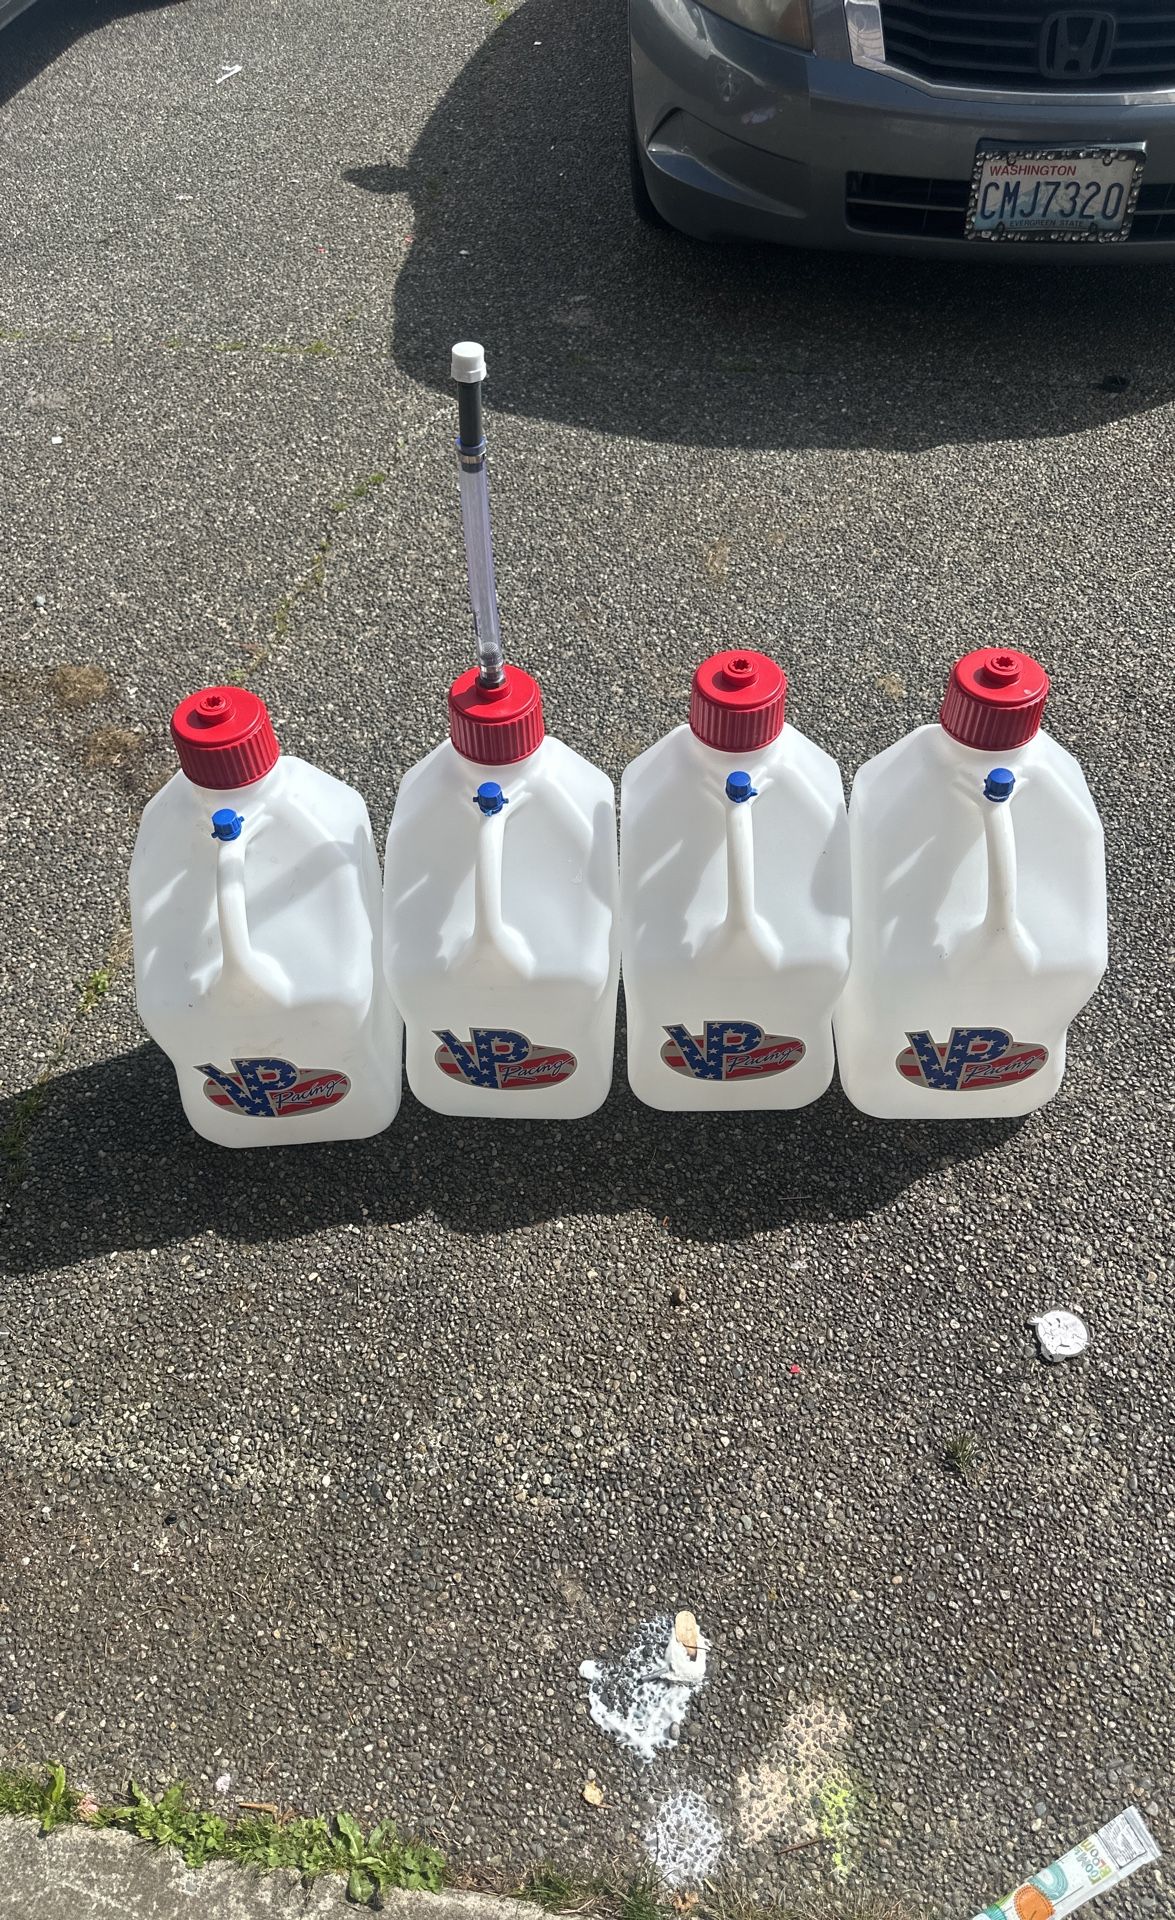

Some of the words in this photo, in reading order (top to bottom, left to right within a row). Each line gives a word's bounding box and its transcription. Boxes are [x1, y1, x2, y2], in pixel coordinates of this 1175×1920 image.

[990, 165, 1077, 176] WASHINGTON
[980, 180, 1124, 221] CMJ7320
[1009, 219, 1055, 227] EVERGREEN
[1058, 219, 1084, 227] STATE
[432, 1027, 531, 1088] VP
[663, 1021, 765, 1080] VP
[728, 1044, 804, 1072] Racing
[905, 1027, 1013, 1090] VP
[500, 1056, 575, 1082] Racing
[965, 1052, 1047, 1083] Racing
[194, 1057, 298, 1117] VP
[272, 1076, 346, 1109] Racing
